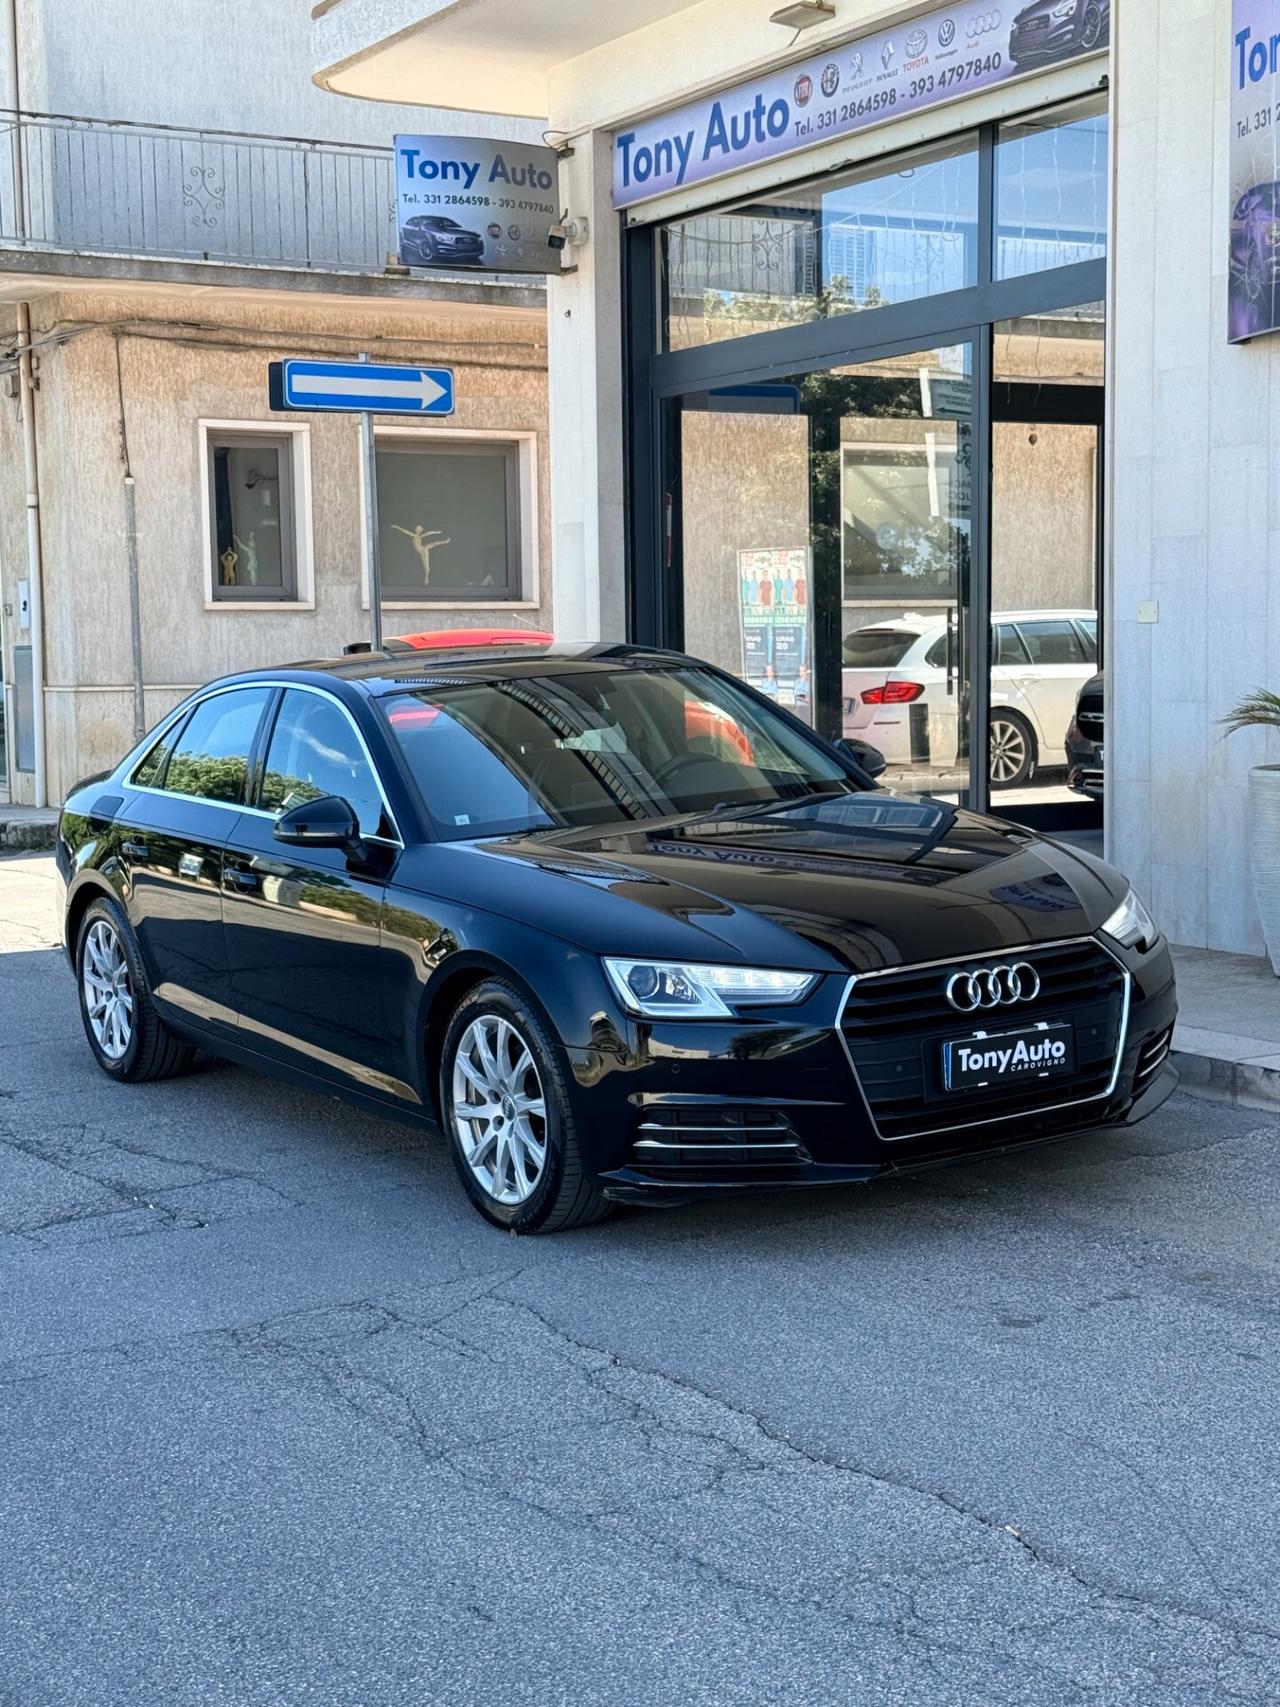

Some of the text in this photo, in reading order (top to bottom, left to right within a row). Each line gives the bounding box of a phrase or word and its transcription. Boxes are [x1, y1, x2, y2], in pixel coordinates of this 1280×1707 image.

[903, 56, 929, 72] TOYOTA
[794, 117, 814, 137] Tel.
[817, 108, 837, 130] 331
[841, 88, 897, 122] 2864598
[909, 74, 935, 98] 393
[938, 52, 1001, 88] 4797840
[842, 78, 872, 94] PEUGEOT
[1237, 116, 1252, 139] Tel.
[1254, 106, 1271, 131] 331
[617, 94, 790, 187] Tony Auto
[400, 149, 553, 190] Tony Auto
[402, 194, 420, 203] Tel.
[423, 194, 441, 204] 331
[444, 195, 490, 206] 2864598
[499, 198, 516, 209] 393
[517, 200, 554, 214] 4797840
[1010, 1057, 1066, 1072] CAROVIGNO
